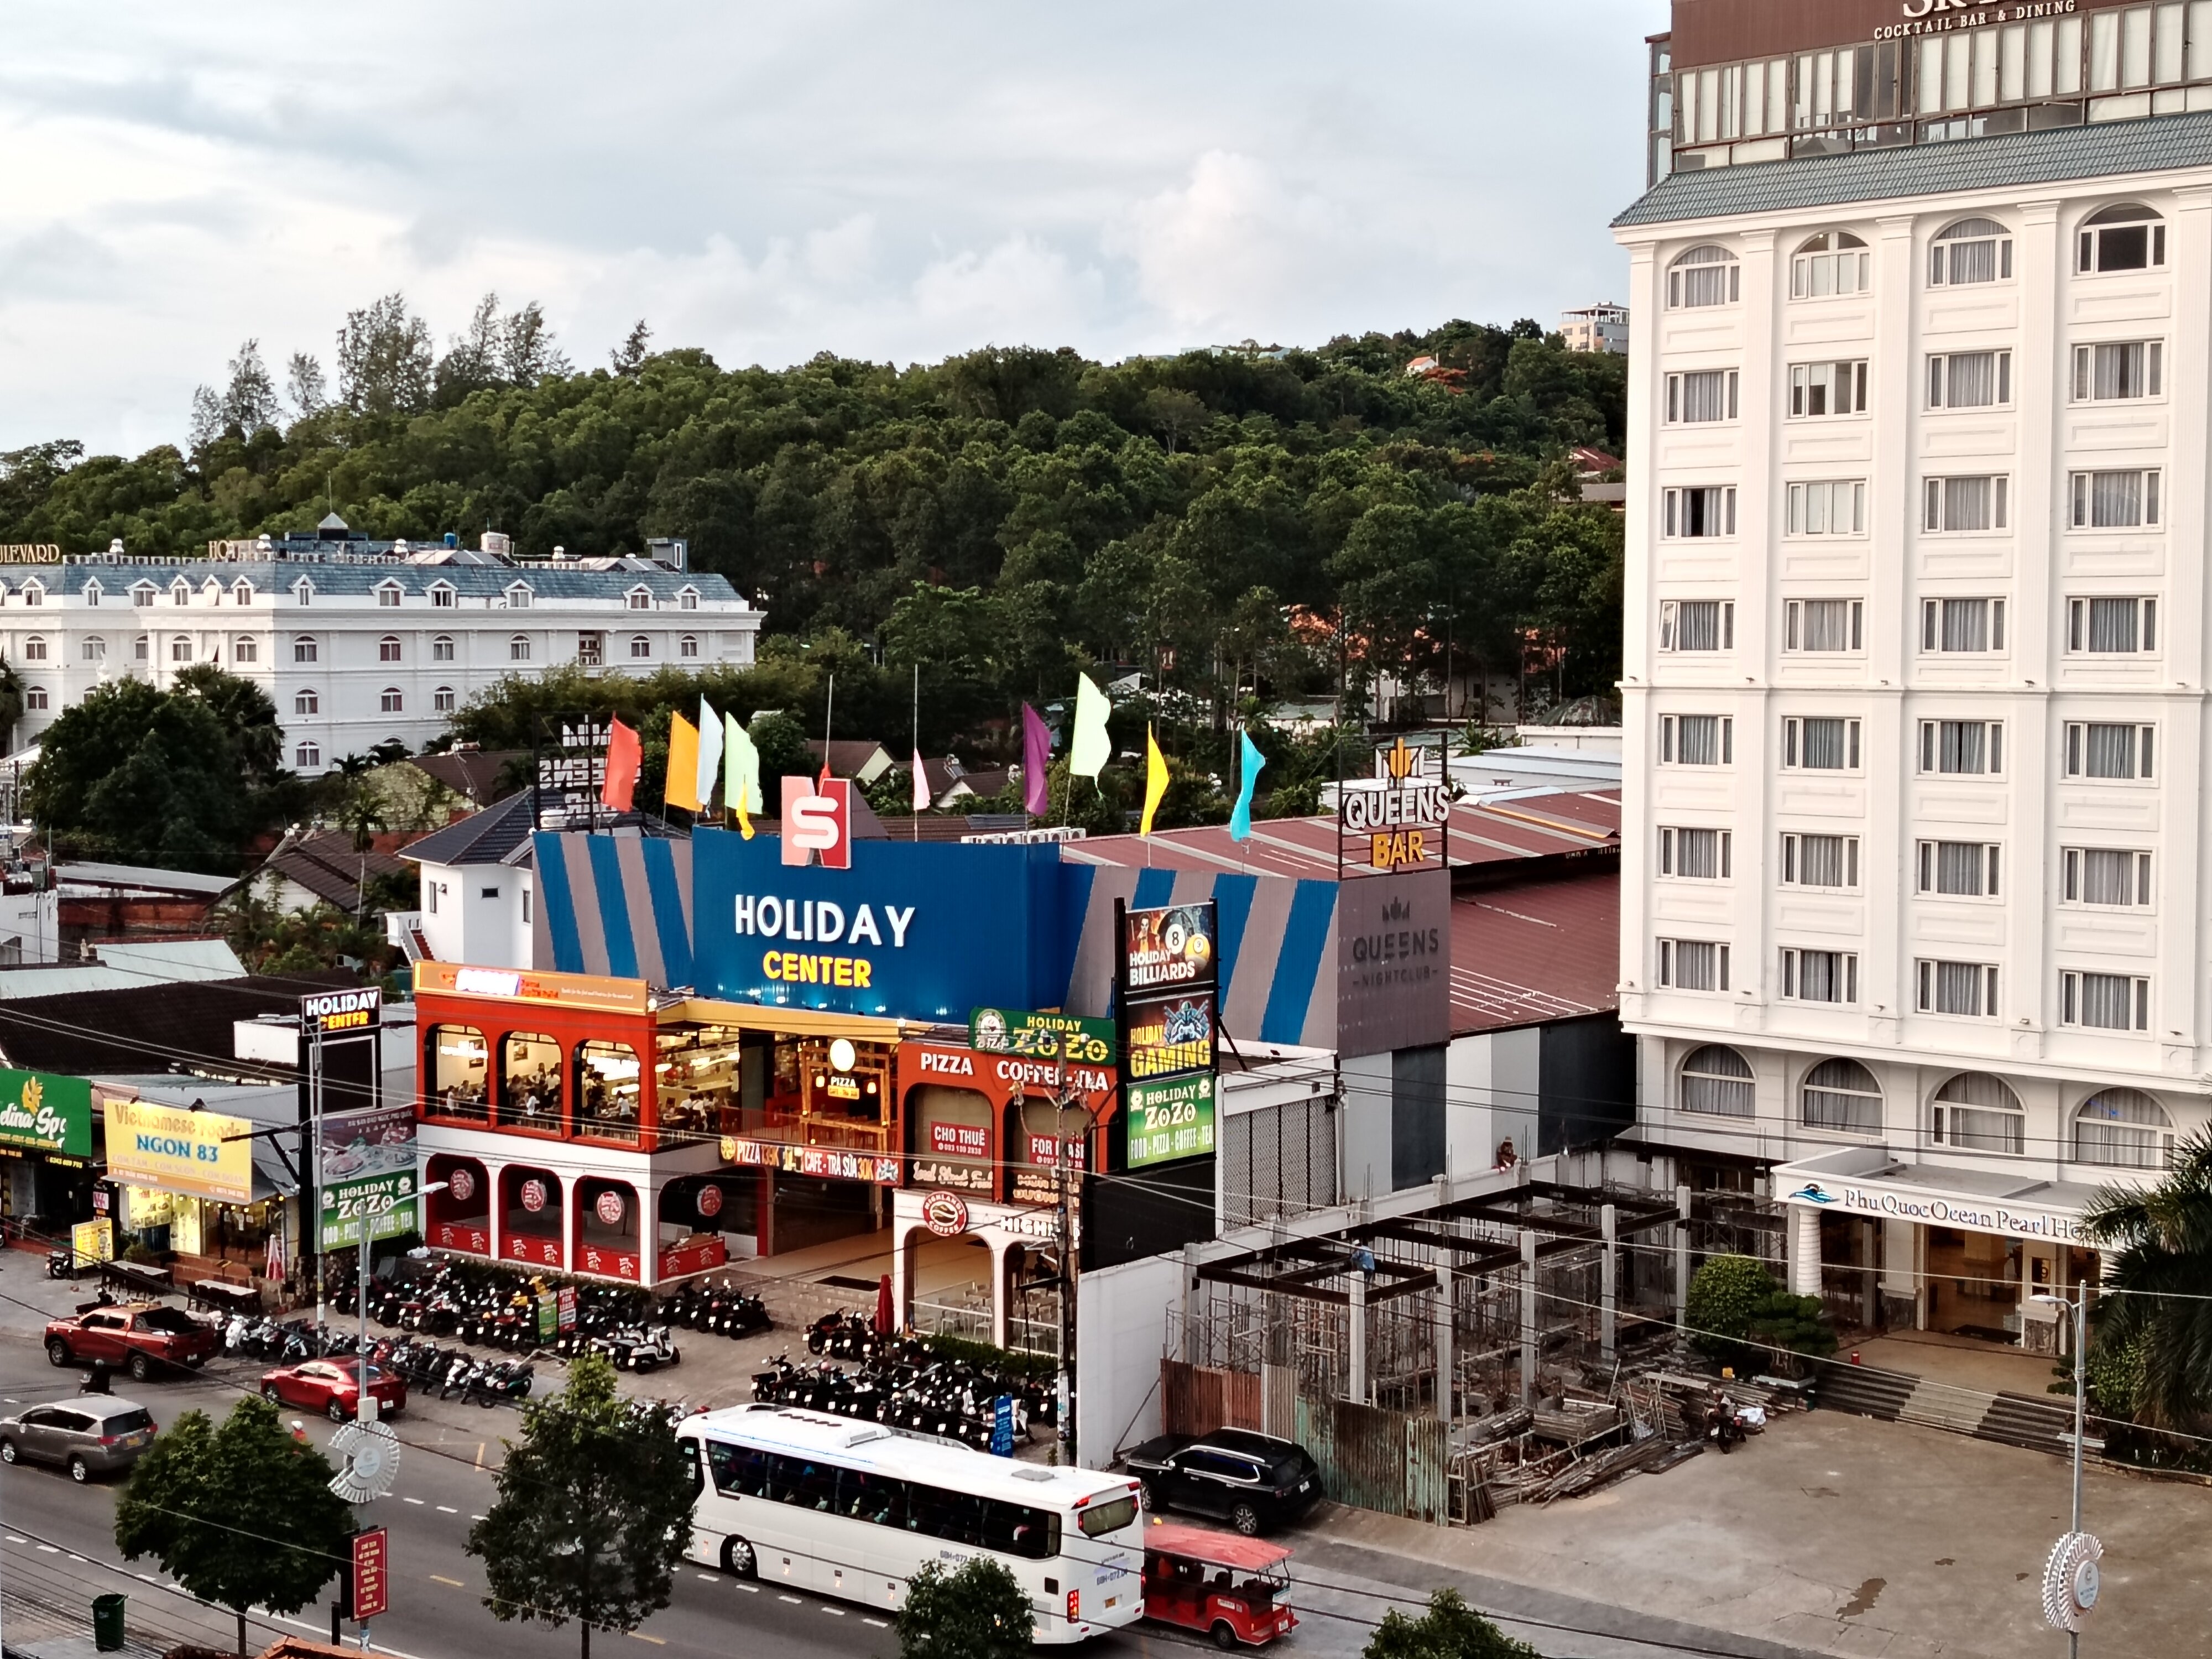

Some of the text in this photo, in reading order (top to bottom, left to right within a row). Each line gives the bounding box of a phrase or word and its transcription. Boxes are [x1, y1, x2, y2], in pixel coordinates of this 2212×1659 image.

[1874, 18, 1952, 39] COCKTAIL
[1960, 12, 1986, 27] BAR
[1997, 9, 2006, 22] &
[2016, 0, 2075, 19] DINING
[0, 544, 59, 562] LEVARD
[1346, 786, 1450, 829] QUEENS
[1373, 831, 1425, 867] BAR
[735, 894, 916, 947] HOLIDAY
[1172, 931, 1180, 946] 8
[1353, 928, 1439, 962] QUEENS
[763, 950, 872, 988] CENTER
[1130, 949, 1172, 967] HOLIDAY
[1130, 961, 1196, 987] BILLIARDS
[306, 991, 378, 1016] HOLIDAY
[1027, 1015, 1081, 1032] HOLIDAY
[1130, 1025, 1164, 1046] HOLIDAY
[921, 1052, 973, 1076] PIZZA
[1131, 1039, 1211, 1077] GAMING
[831, 1076, 856, 1088] PIZZA
[1146, 1084, 1196, 1106] HOLIDAY
[114, 1104, 196, 1135] Vietnamese
[137, 1134, 218, 1162] NGON 83
[935, 1126, 985, 1146] CHO THUÊ
[1032, 1138, 1052, 1155] FOR
[1130, 1136, 1147, 1160] FOOD
[1152, 1133, 1170, 1156] PIZZA
[1175, 1127, 1197, 1151] COFFEE
[1201, 1124, 1213, 1145] TEA
[737, 1140, 760, 1164] PIZZA
[805, 1151, 823, 1173] CAFE
[827, 1152, 842, 1176] TRÀ
[858, 1157, 874, 1181] 30K
[339, 1179, 394, 1199] HOLIDAY
[925, 1194, 964, 1215] HIGHLANDS
[1845, 1189, 1879, 1211] Phu
[1881, 1192, 1931, 1218] Quoc
[1931, 1200, 1994, 1229] Ocean
[1996, 1209, 2048, 1237] Pearl
[323, 1225, 338, 1245] OOD
[929, 1220, 959, 1234] COFFEE
